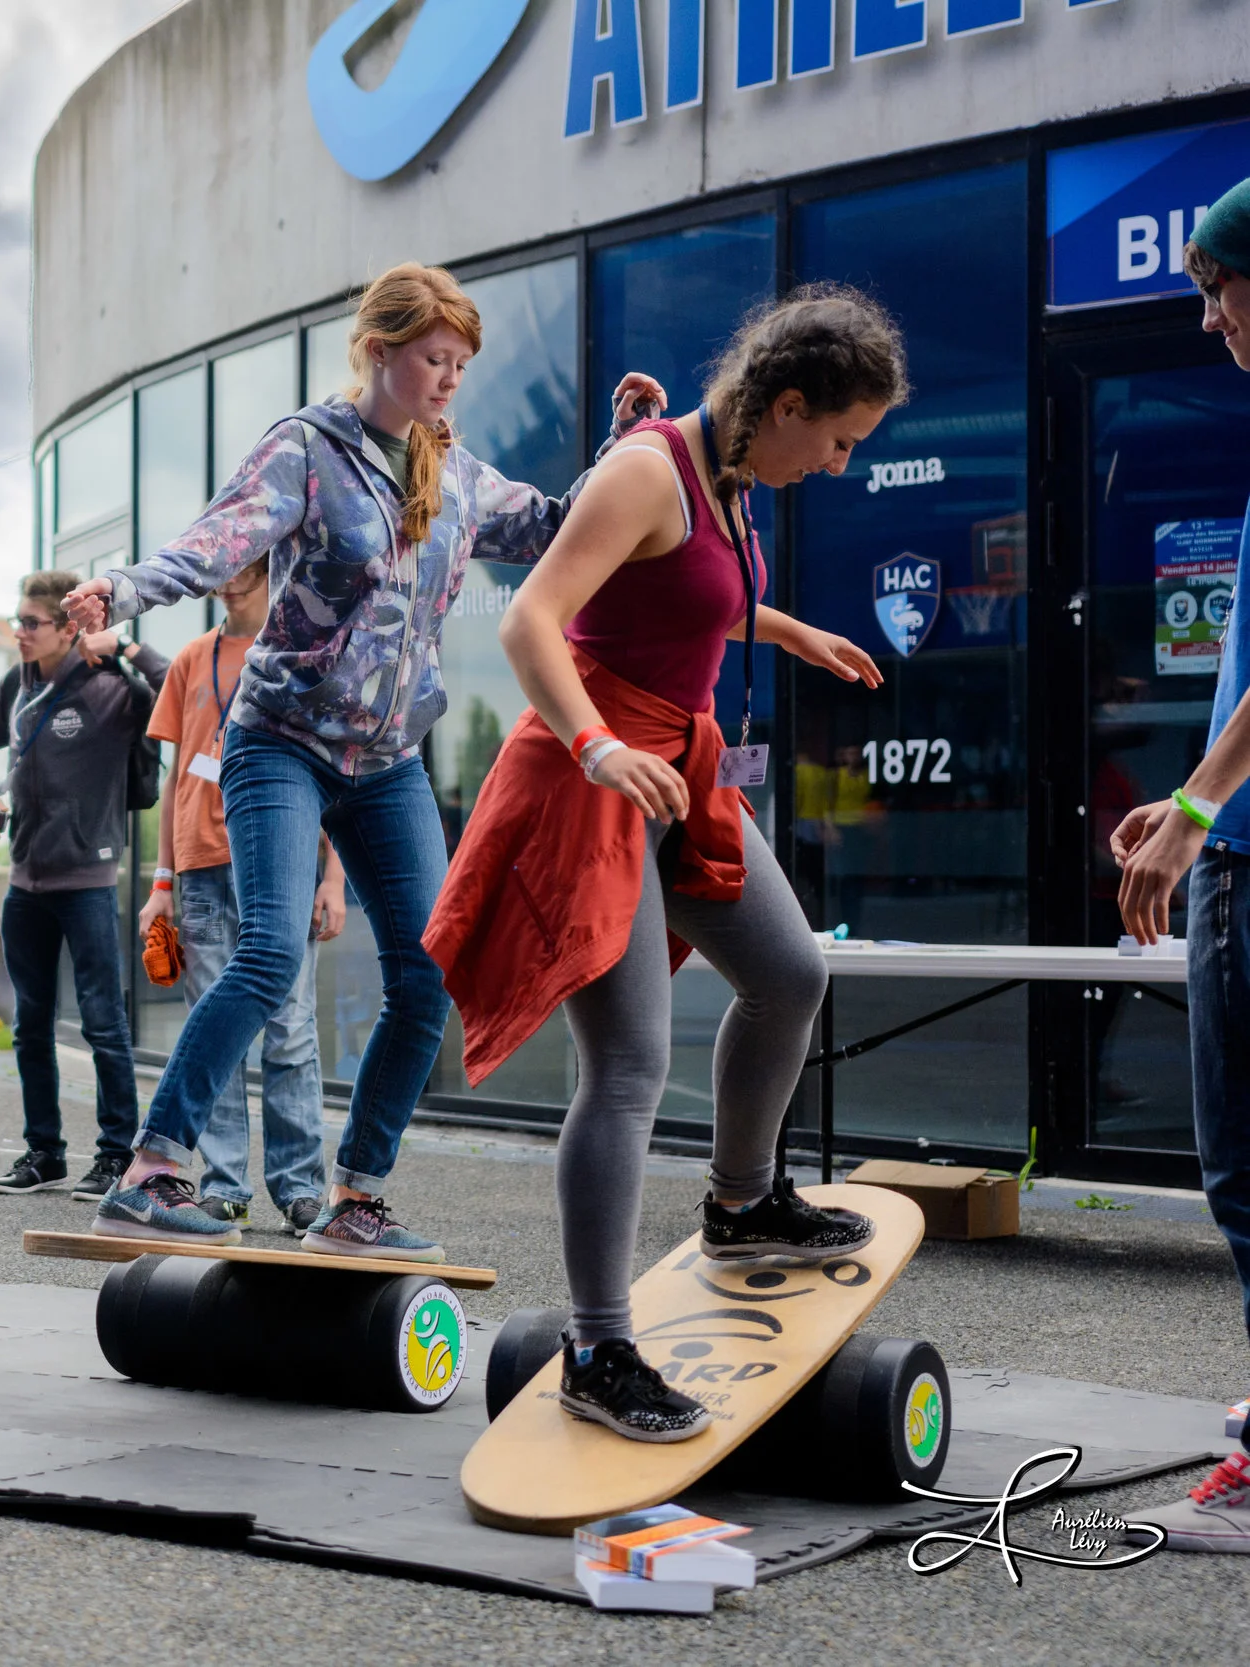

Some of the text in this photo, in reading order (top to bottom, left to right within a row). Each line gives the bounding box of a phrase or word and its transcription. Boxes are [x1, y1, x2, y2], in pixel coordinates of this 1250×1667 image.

[883, 564, 931, 592] HAC
[1162, 564, 1200, 575] Vendredi
[1203, 563, 1214, 572] 14
[453, 584, 519, 616] Billett
[862, 738, 951, 784] 1872
